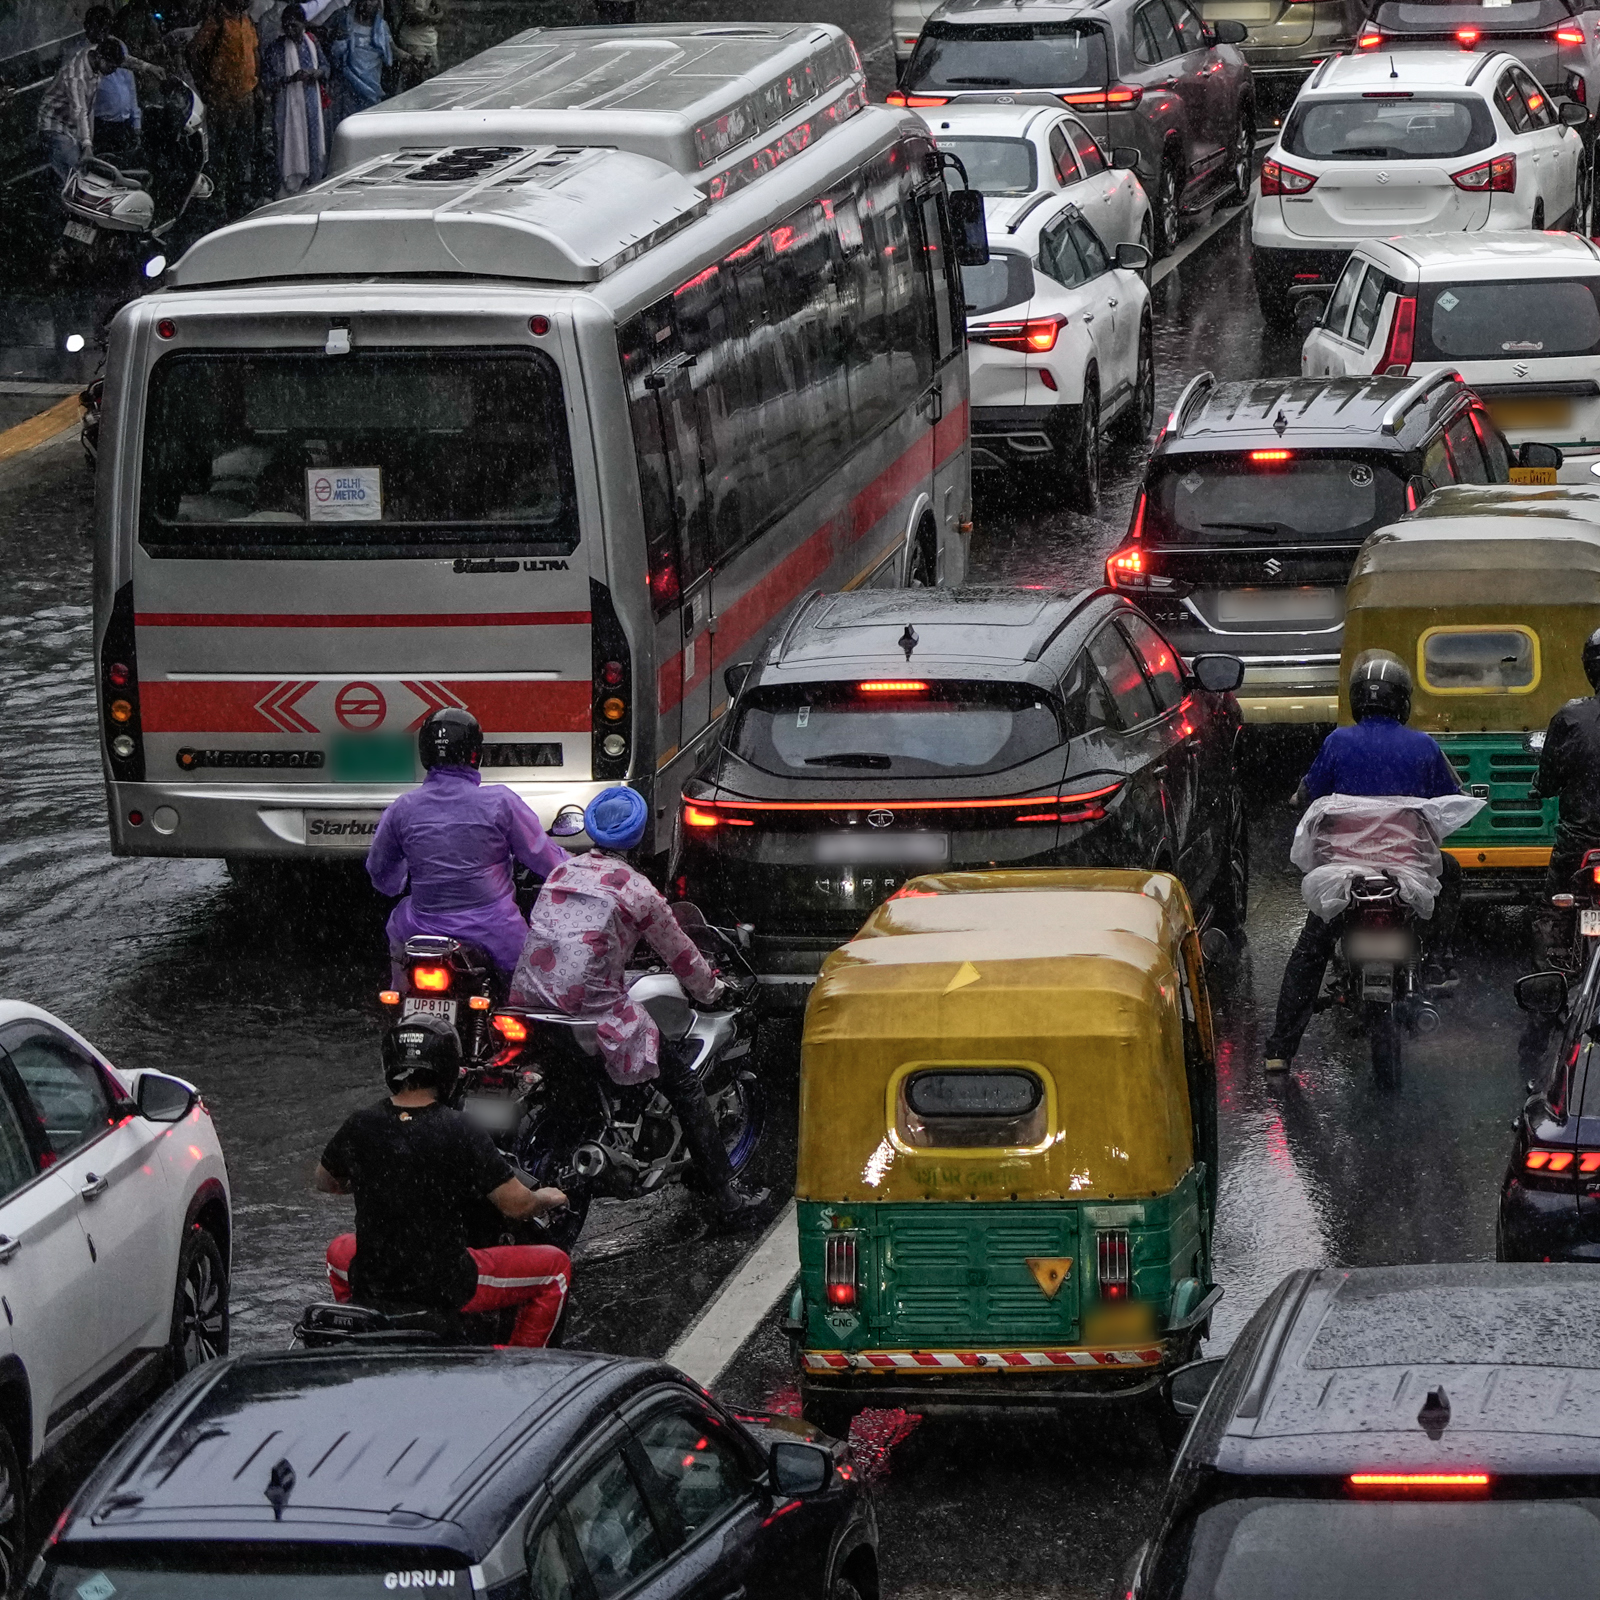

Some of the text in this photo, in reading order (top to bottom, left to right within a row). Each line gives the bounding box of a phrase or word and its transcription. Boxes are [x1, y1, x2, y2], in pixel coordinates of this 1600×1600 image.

[336, 477, 362, 490] DELHI
[333, 488, 367, 501] METRO
[523, 560, 570, 572] ULTRA
[1155, 612, 1190, 621] XL6
[413, 999, 450, 1013] UP81D
[398, 1033, 425, 1044] STUDDS
[832, 1317, 853, 1328] CNG
[384, 1569, 456, 1590] GURUJI
